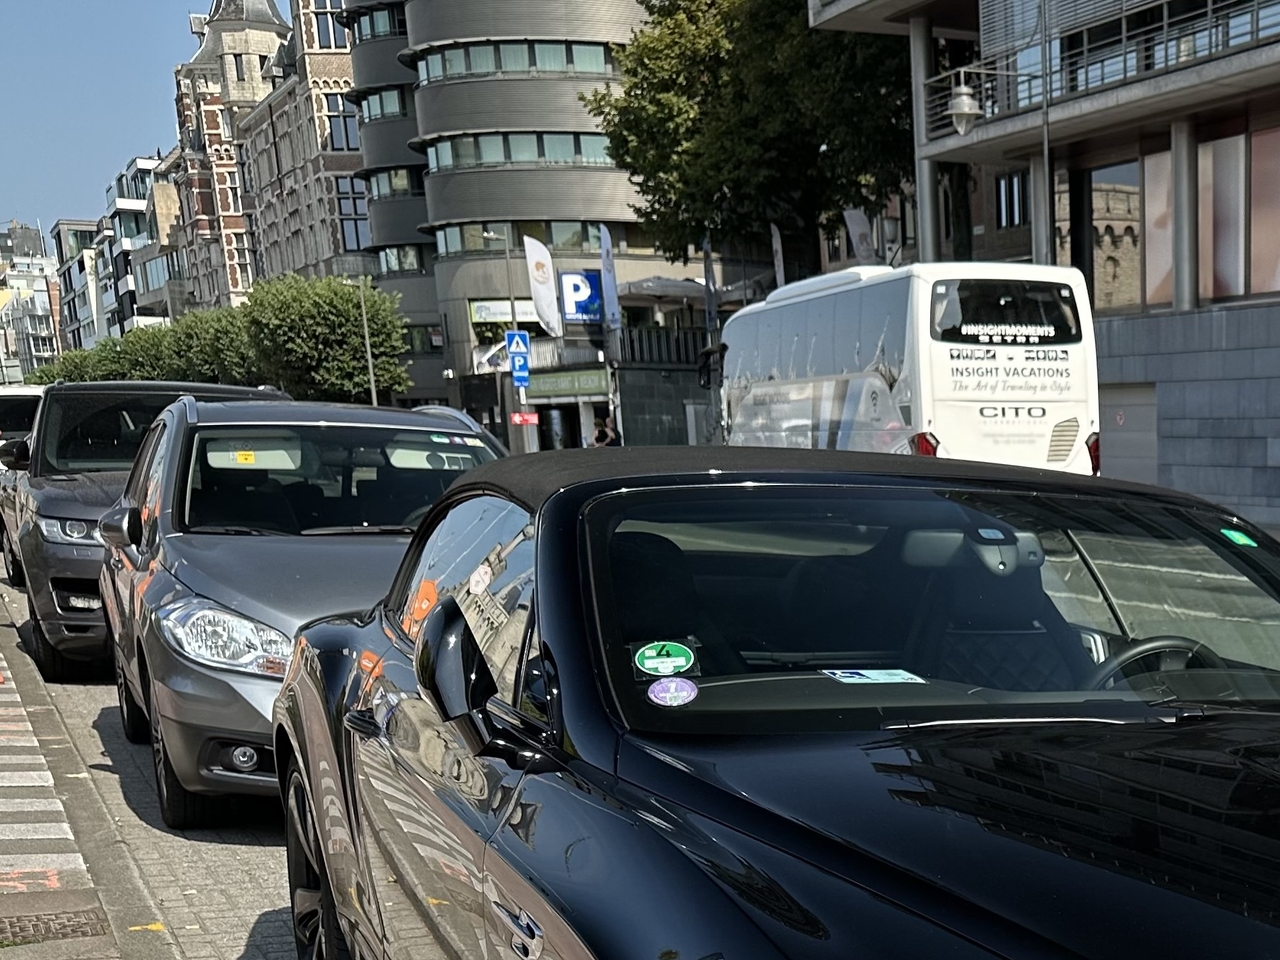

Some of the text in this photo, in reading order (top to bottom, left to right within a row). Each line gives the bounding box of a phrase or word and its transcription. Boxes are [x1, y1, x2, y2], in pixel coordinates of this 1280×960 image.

[562, 274, 591, 313] P
[961, 324, 1055, 337] #INSIGHTMOMENTS
[979, 335, 1039, 343] SETRA
[514, 356, 524, 370] P
[951, 367, 1071, 378] INSIGHT VACATIONS
[952, 380, 969, 392] The
[972, 380, 989, 392] Art
[990, 380, 1000, 395] of
[1050, 380, 1072, 395] Style
[979, 406, 1046, 418] CITO
[656, 644, 672, 657] 4
